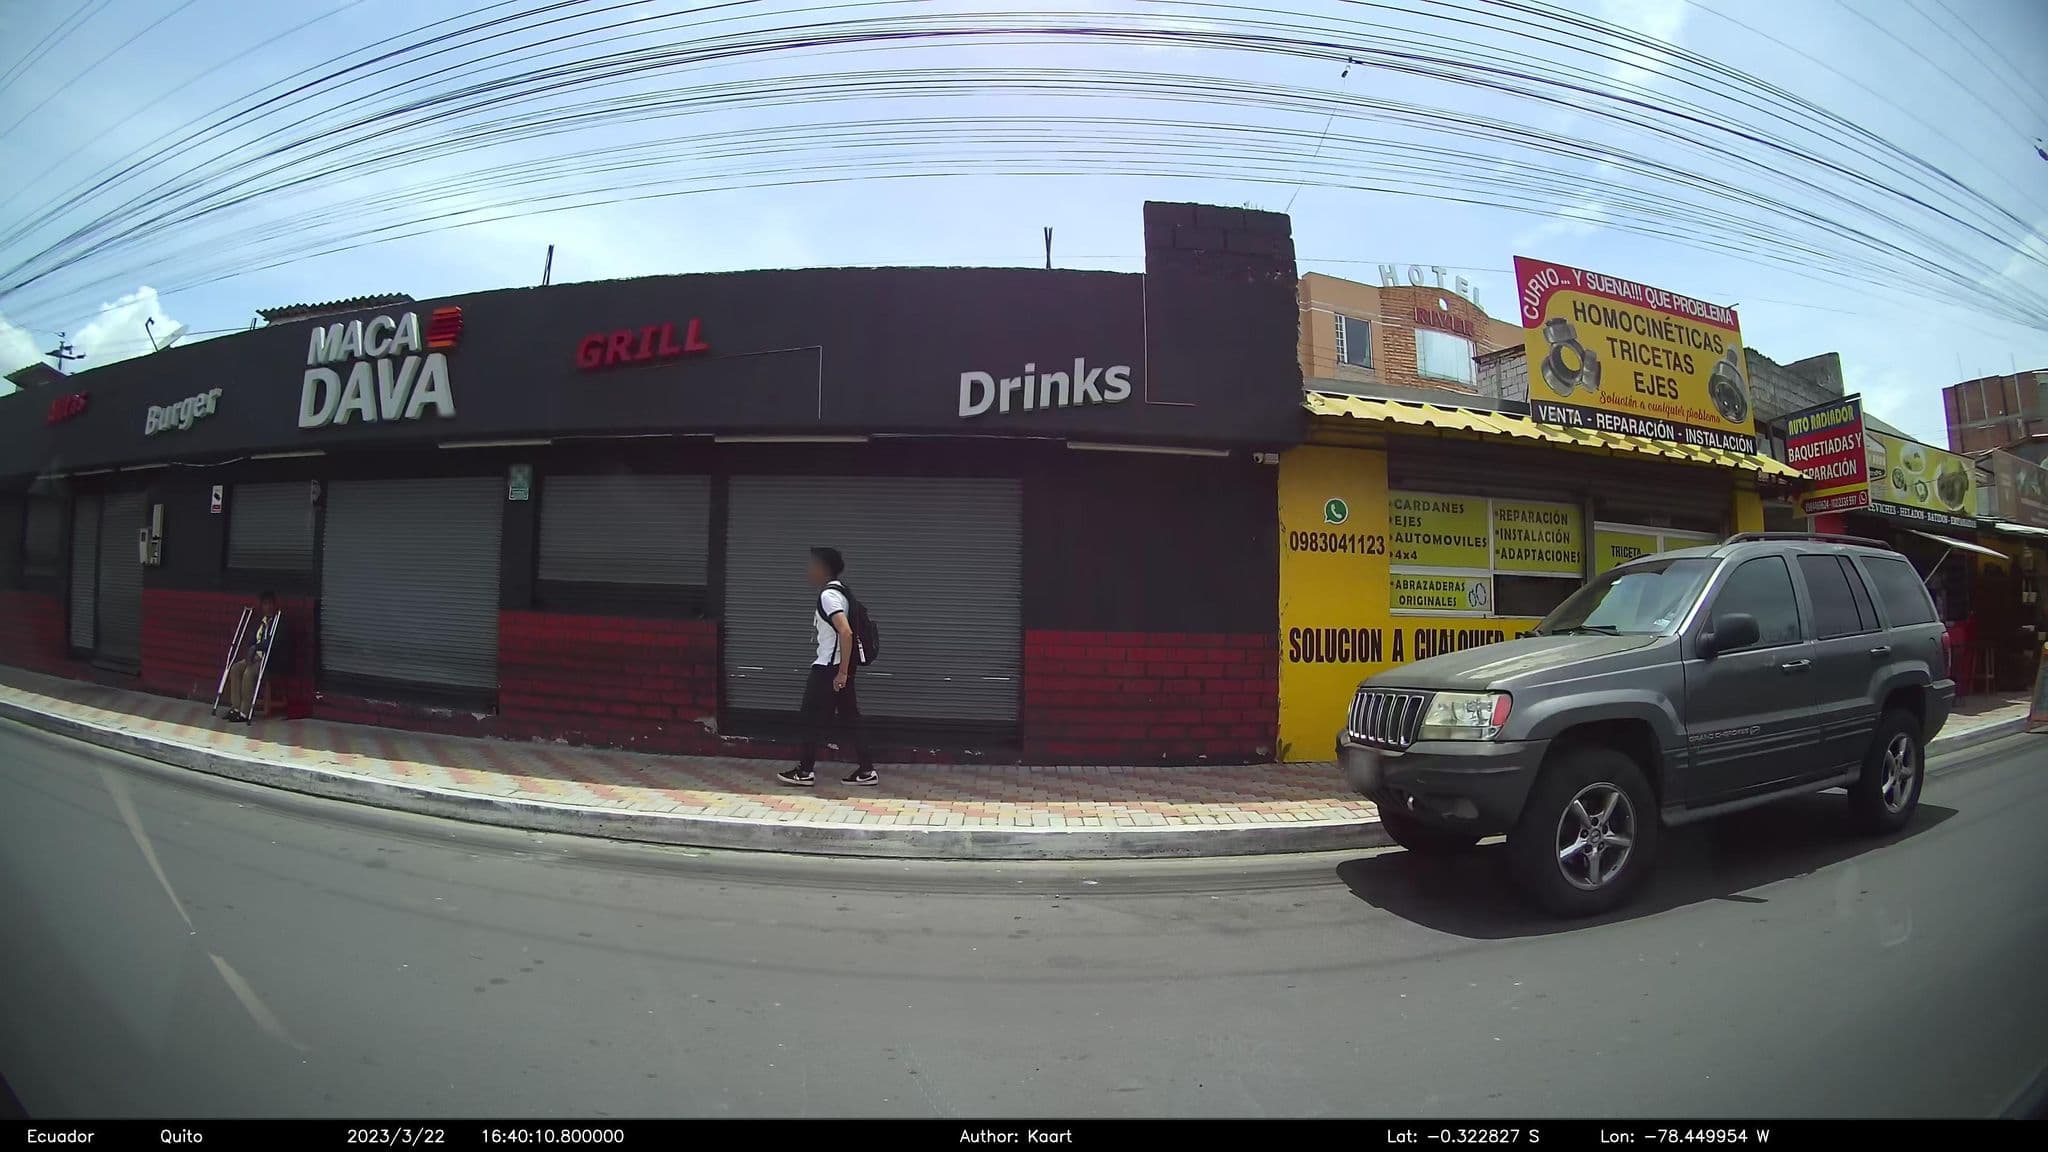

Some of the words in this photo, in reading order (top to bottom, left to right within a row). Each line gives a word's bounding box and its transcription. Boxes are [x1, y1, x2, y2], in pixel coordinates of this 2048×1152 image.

[1378, 264, 1484, 309] HOTEL
[1573, 269, 1584, 287] Y
[1587, 272, 1643, 302] SUENA!!!
[1645, 287, 1672, 310] QUE
[1673, 295, 1734, 326] PROBLEMA
[307, 312, 422, 365] MACA
[576, 317, 710, 369] GRILL
[1573, 300, 1725, 355] HOMOCINÉTICAS
[1606, 336, 1695, 375] TRICETAS
[298, 352, 456, 428] DAVA
[958, 357, 1132, 418] Drinks
[1633, 371, 1679, 400] EJES
[144, 387, 223, 436] Burger
[1788, 416, 1809, 436] AUTO
[1810, 405, 1855, 431] RADIADOR
[1539, 405, 1583, 426] VENTA
[1596, 412, 1675, 442] REPARACIÓN
[1685, 427, 1754, 454] INSTALACIÓN
[1788, 434, 1855, 463] BAQUETIADAS
[1854, 431, 1863, 448] Y
[1802, 457, 1857, 481] PARACIÓN
[1394, 498, 1465, 515] CARDANES
[1394, 516, 1422, 528] EJES
[1499, 508, 1568, 526] REPARACIÓN
[1289, 531, 1386, 555] 0983041123
[1394, 532, 1488, 549] AUTOMOVILES
[1499, 528, 1570, 545] INSTALACIÓN
[1394, 549, 1418, 561] 4x4
[1500, 549, 1581, 564] ADAPTACIONES
[1394, 579, 1466, 592] ABRAZADERAS
[1398, 595, 1457, 607] ORIGINALES
[1289, 627, 1382, 663] SOLUCION
[1391, 628, 1404, 663] A
